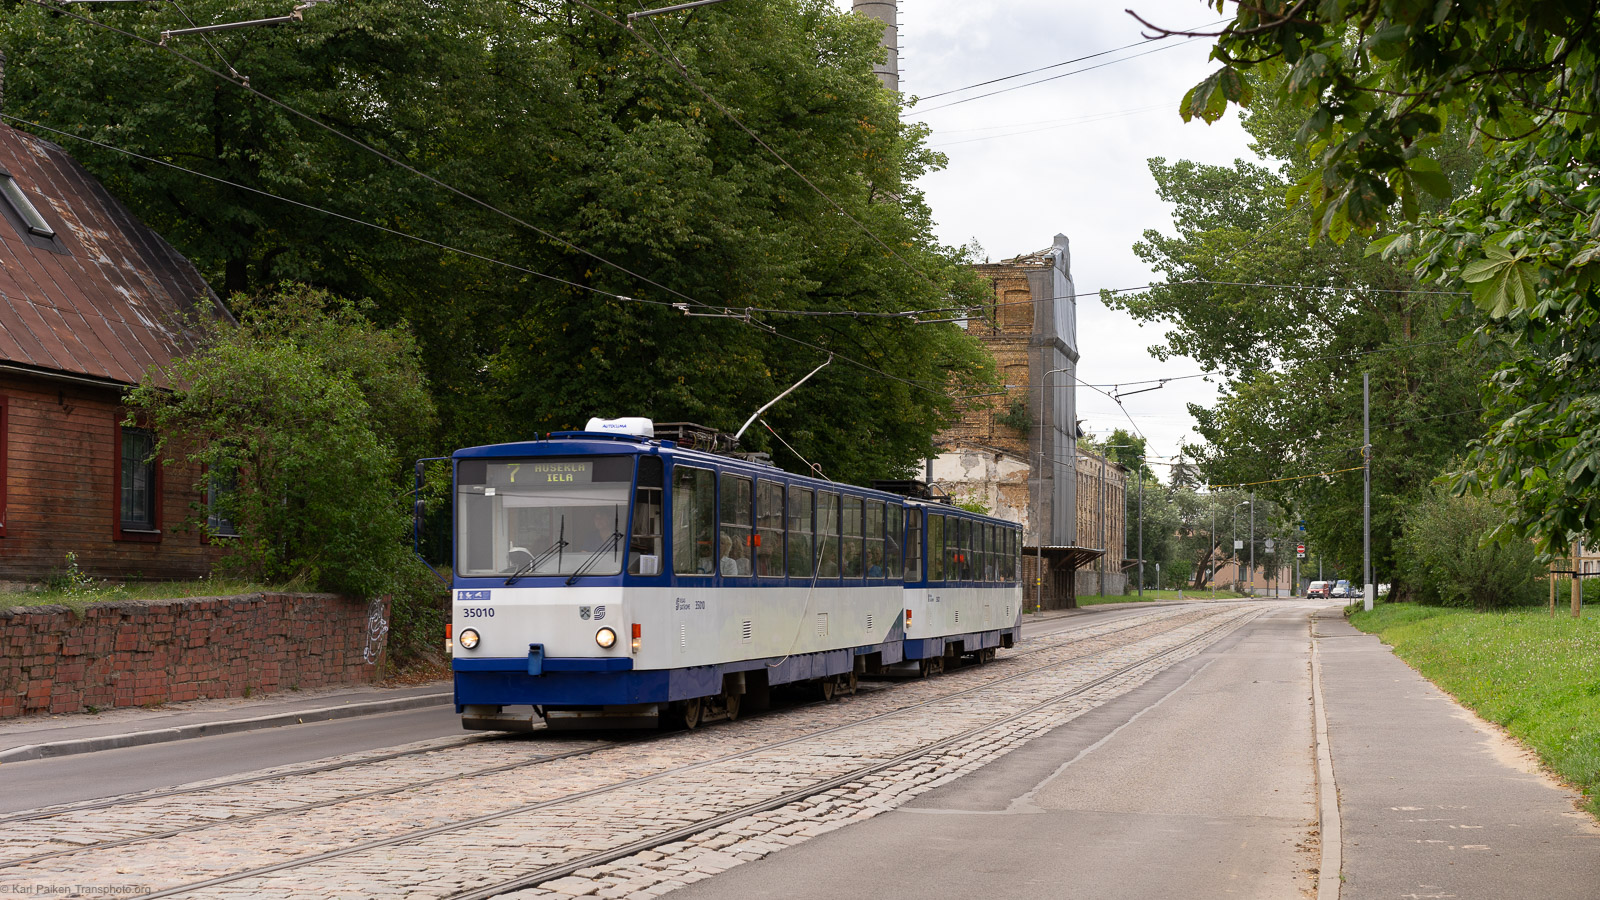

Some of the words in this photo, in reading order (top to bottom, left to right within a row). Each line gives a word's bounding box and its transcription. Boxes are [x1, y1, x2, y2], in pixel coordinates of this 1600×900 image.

[507, 463, 520, 483] 7
[534, 464, 585, 473] AUSEKĻA
[547, 473, 573, 482] IELA
[463, 607, 495, 618] 35010
